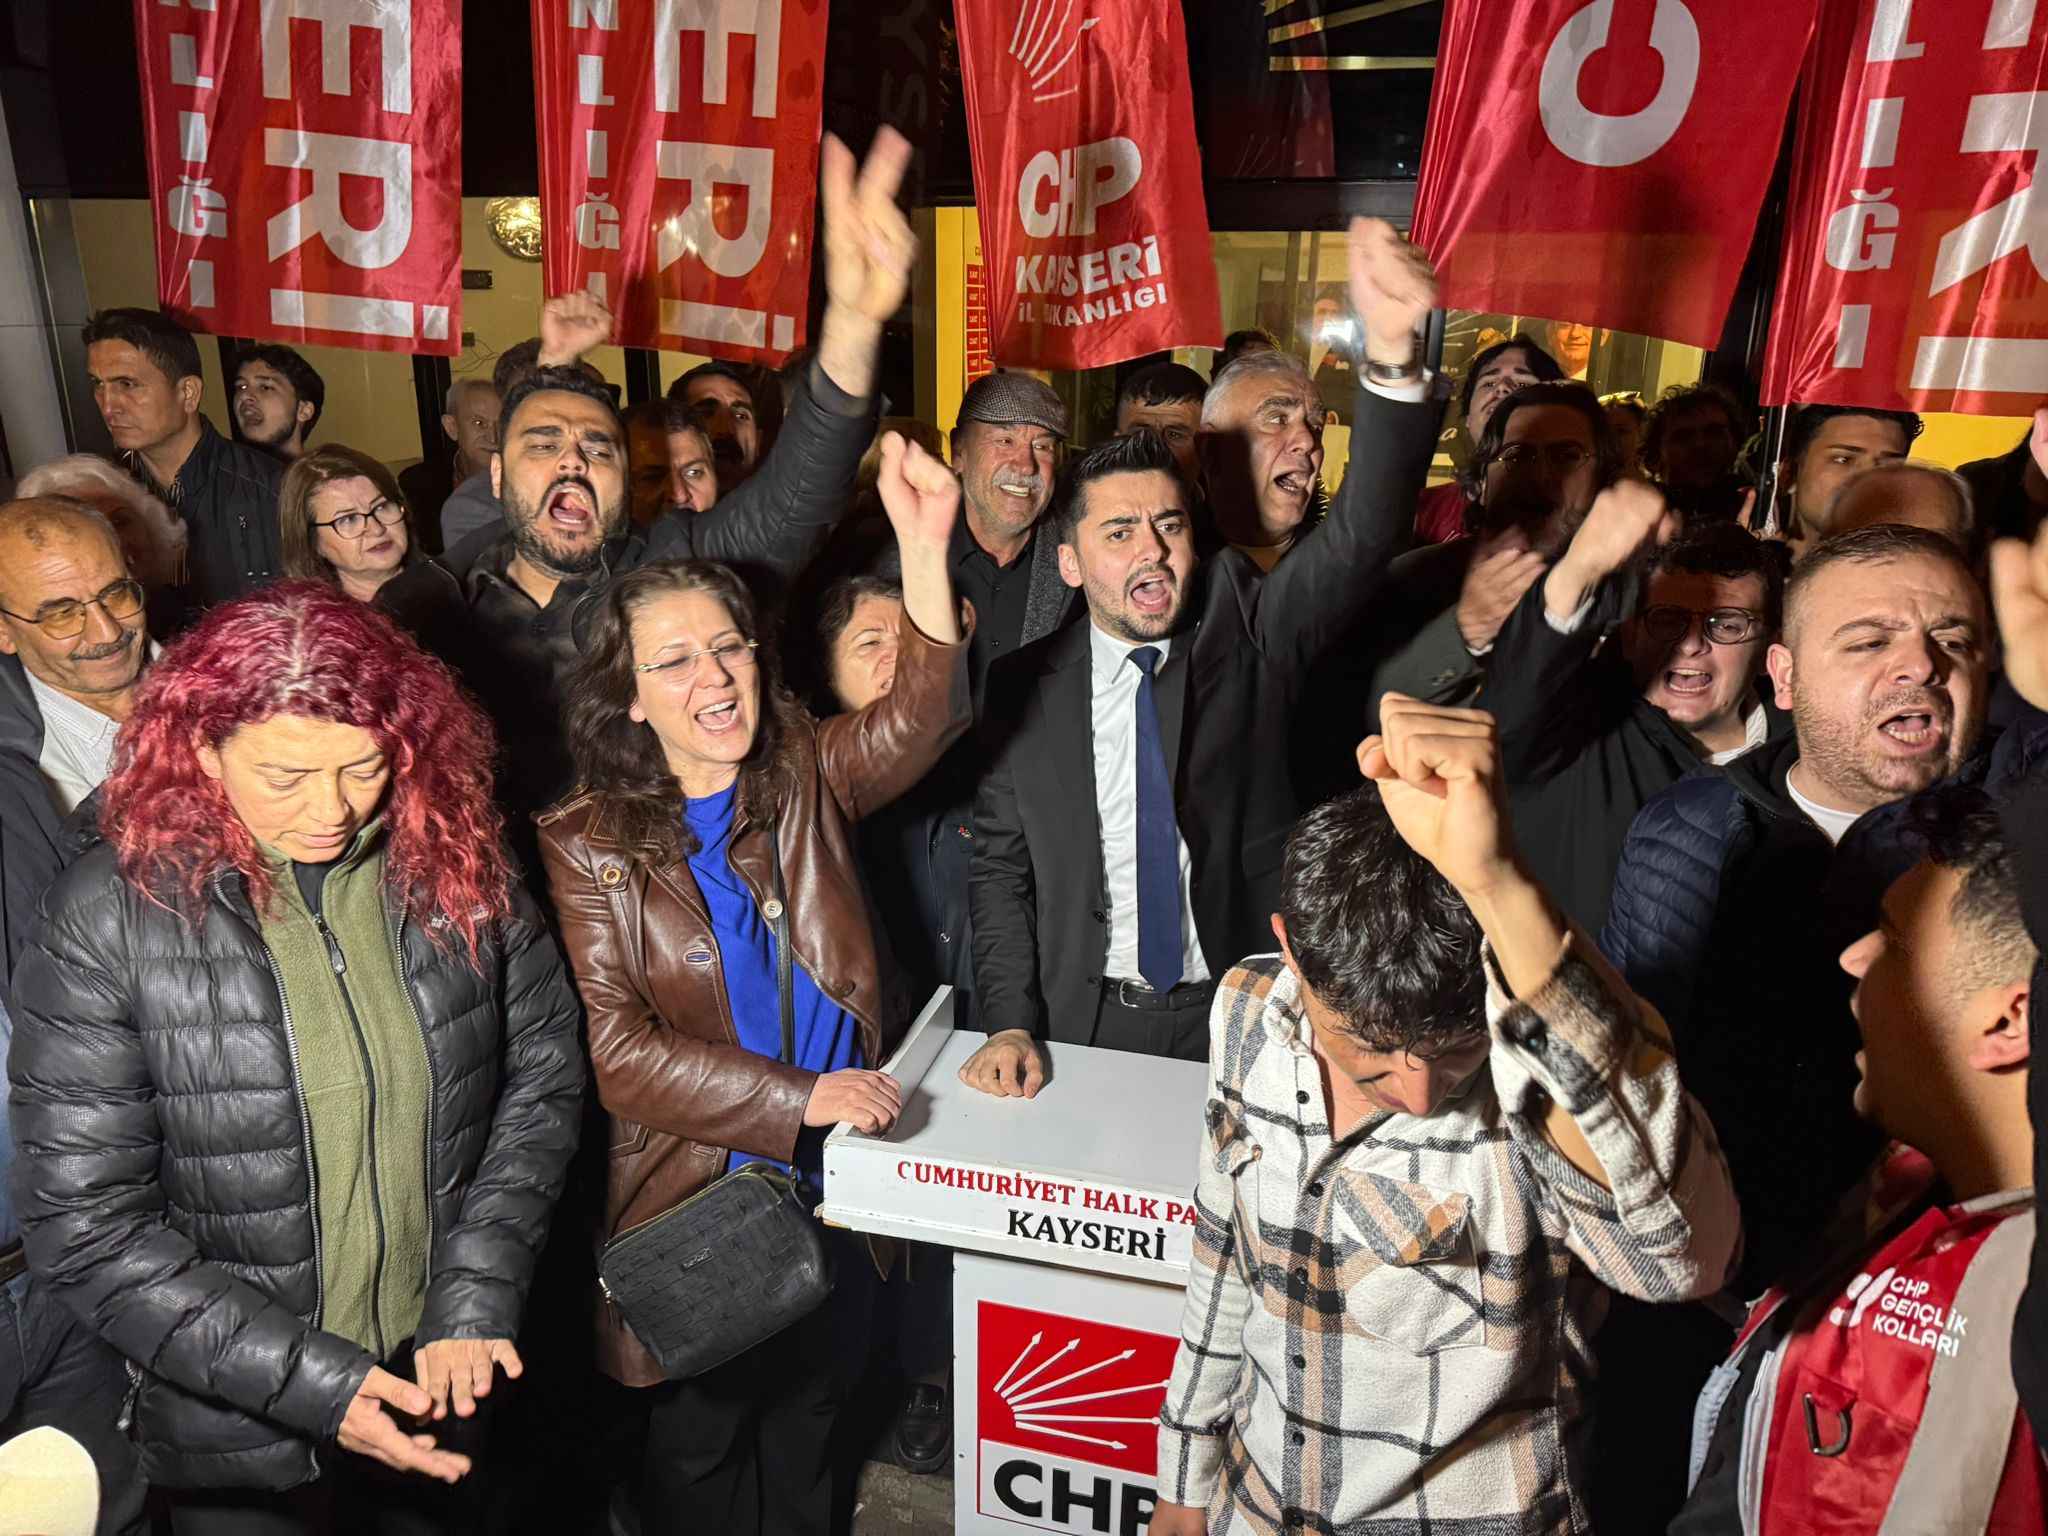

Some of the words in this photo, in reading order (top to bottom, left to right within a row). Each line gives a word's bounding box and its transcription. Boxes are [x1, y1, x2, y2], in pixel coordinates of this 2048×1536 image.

[1019, 137, 1142, 238] CHP
[897, 1160, 1076, 1205] CUMHURİYET
[1083, 1187, 1159, 1220] HALK
[1007, 1208, 1166, 1261] KAYSERİ
[1890, 1277, 1929, 1298] CHP
[1873, 1314, 1959, 1357] KOLLARI
[1881, 1294, 1968, 1336] GENÇLİK
[993, 1459, 1158, 1536] CHP
